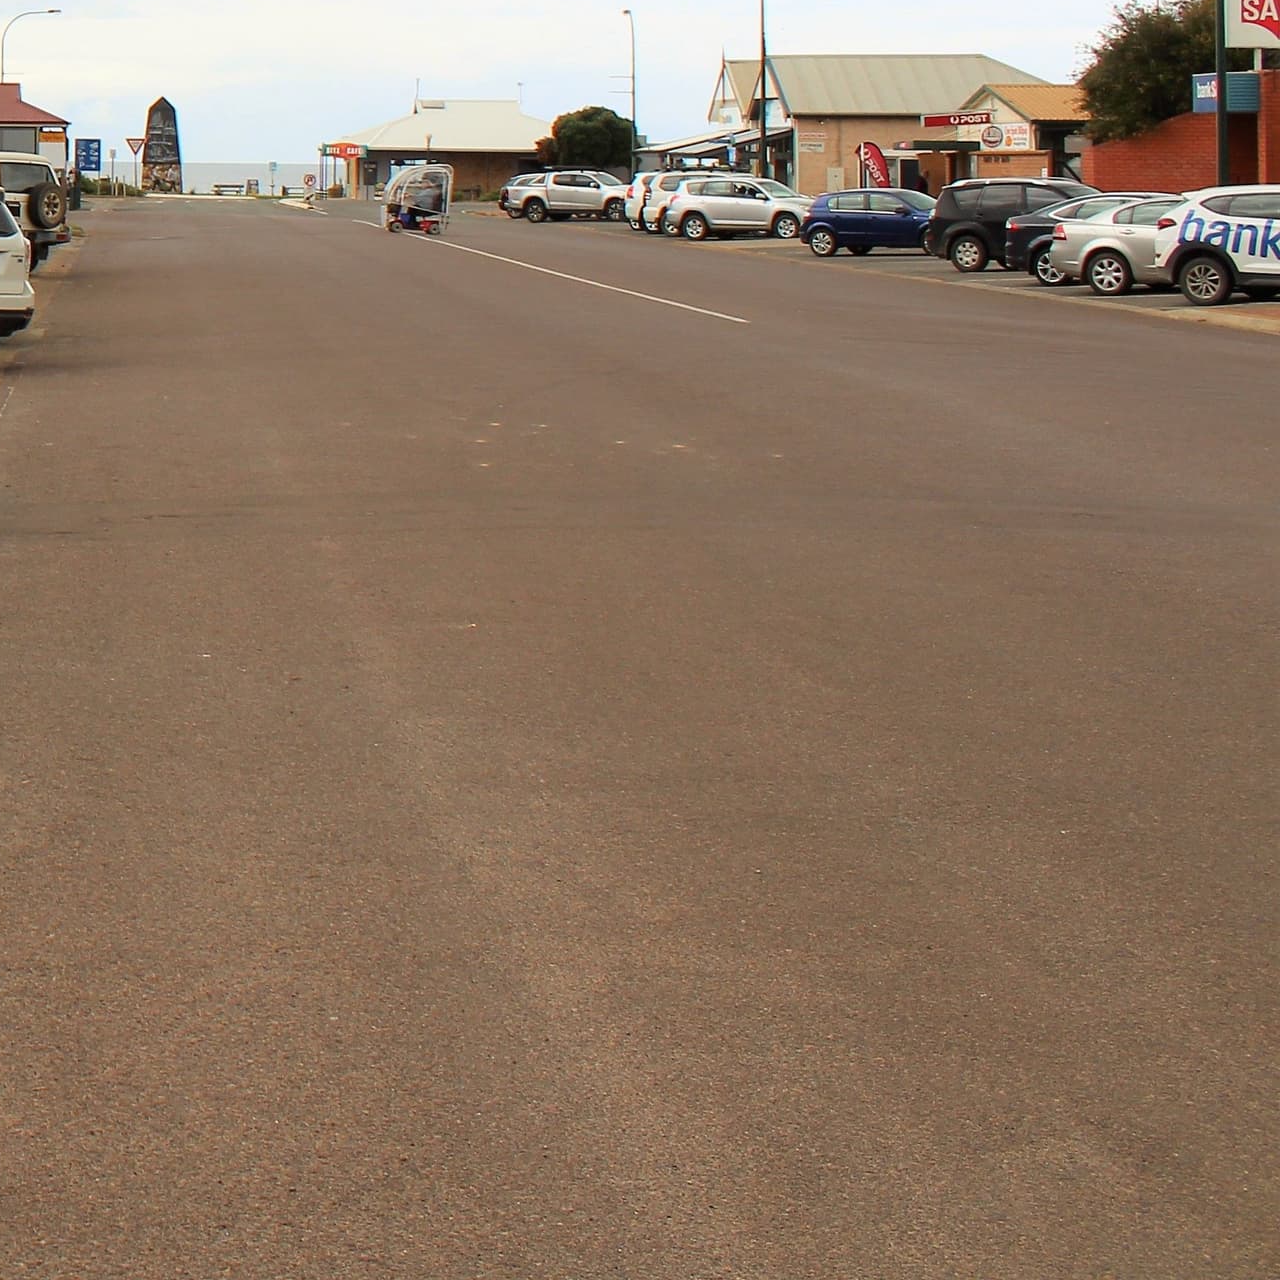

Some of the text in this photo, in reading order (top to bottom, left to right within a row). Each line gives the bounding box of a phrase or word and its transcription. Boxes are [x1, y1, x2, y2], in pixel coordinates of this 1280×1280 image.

[960, 114, 988, 123] POST
[865, 159, 885, 184] POST
[1178, 209, 1280, 260] bank
